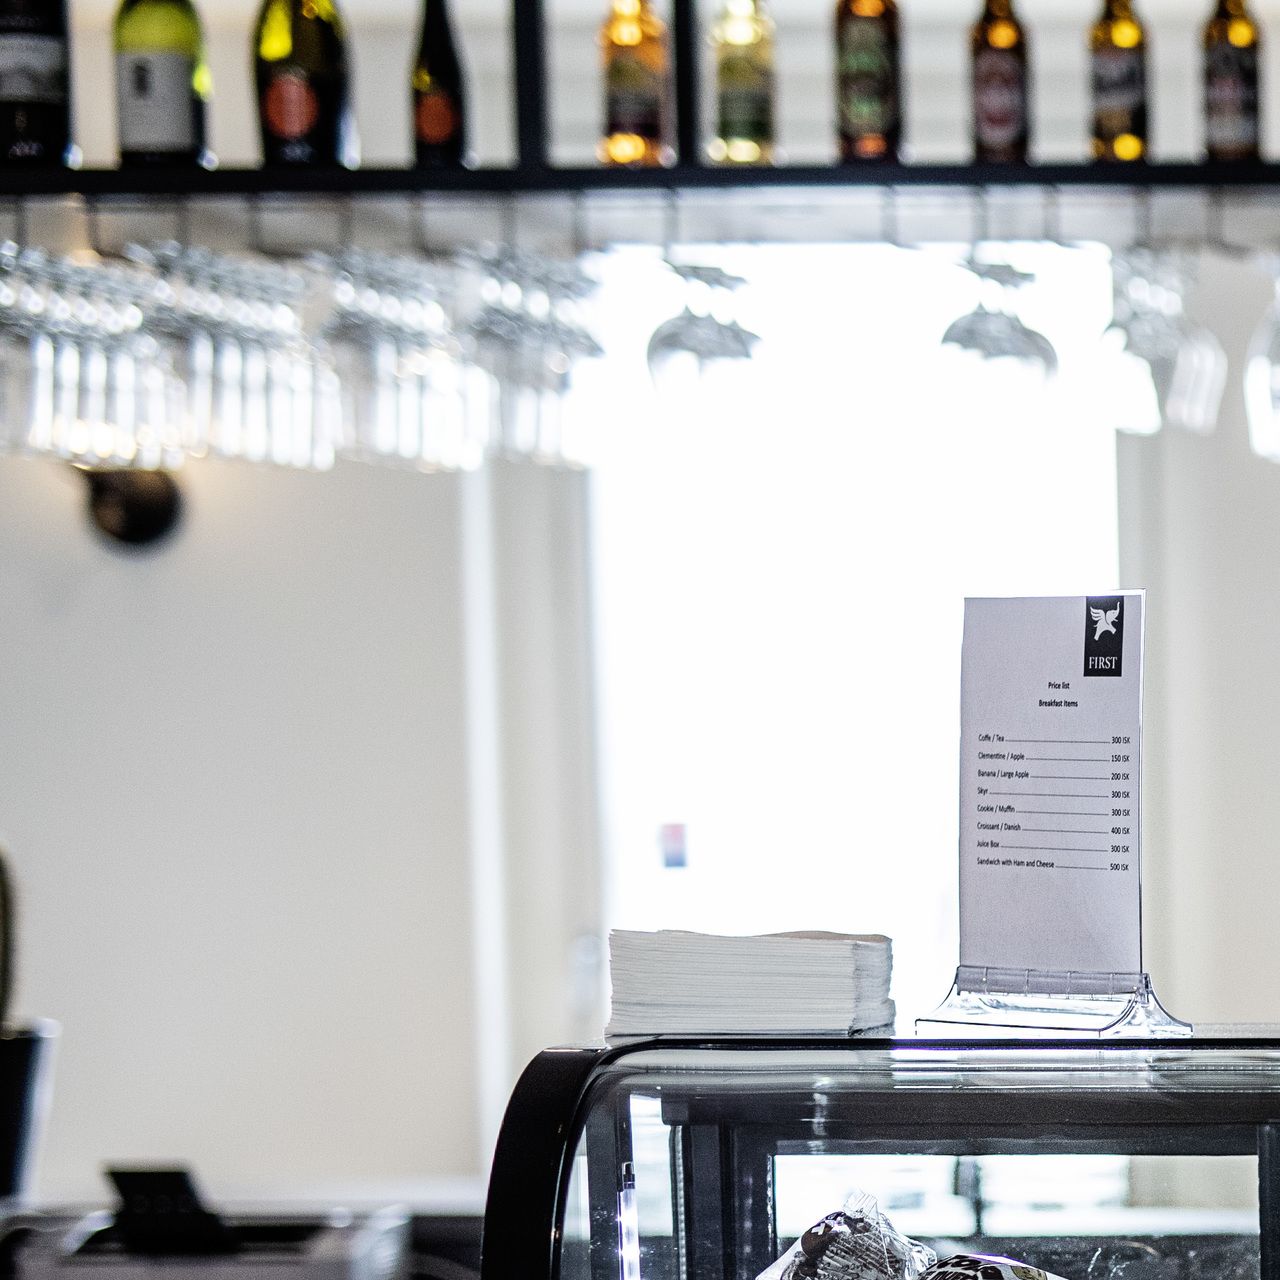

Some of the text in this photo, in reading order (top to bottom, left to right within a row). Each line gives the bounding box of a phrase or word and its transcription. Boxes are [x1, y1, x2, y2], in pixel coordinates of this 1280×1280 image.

[1088, 656, 1118, 669] FIRST
[1048, 682, 1070, 691] Price list
[1039, 699, 1078, 708] Breakfast Items
